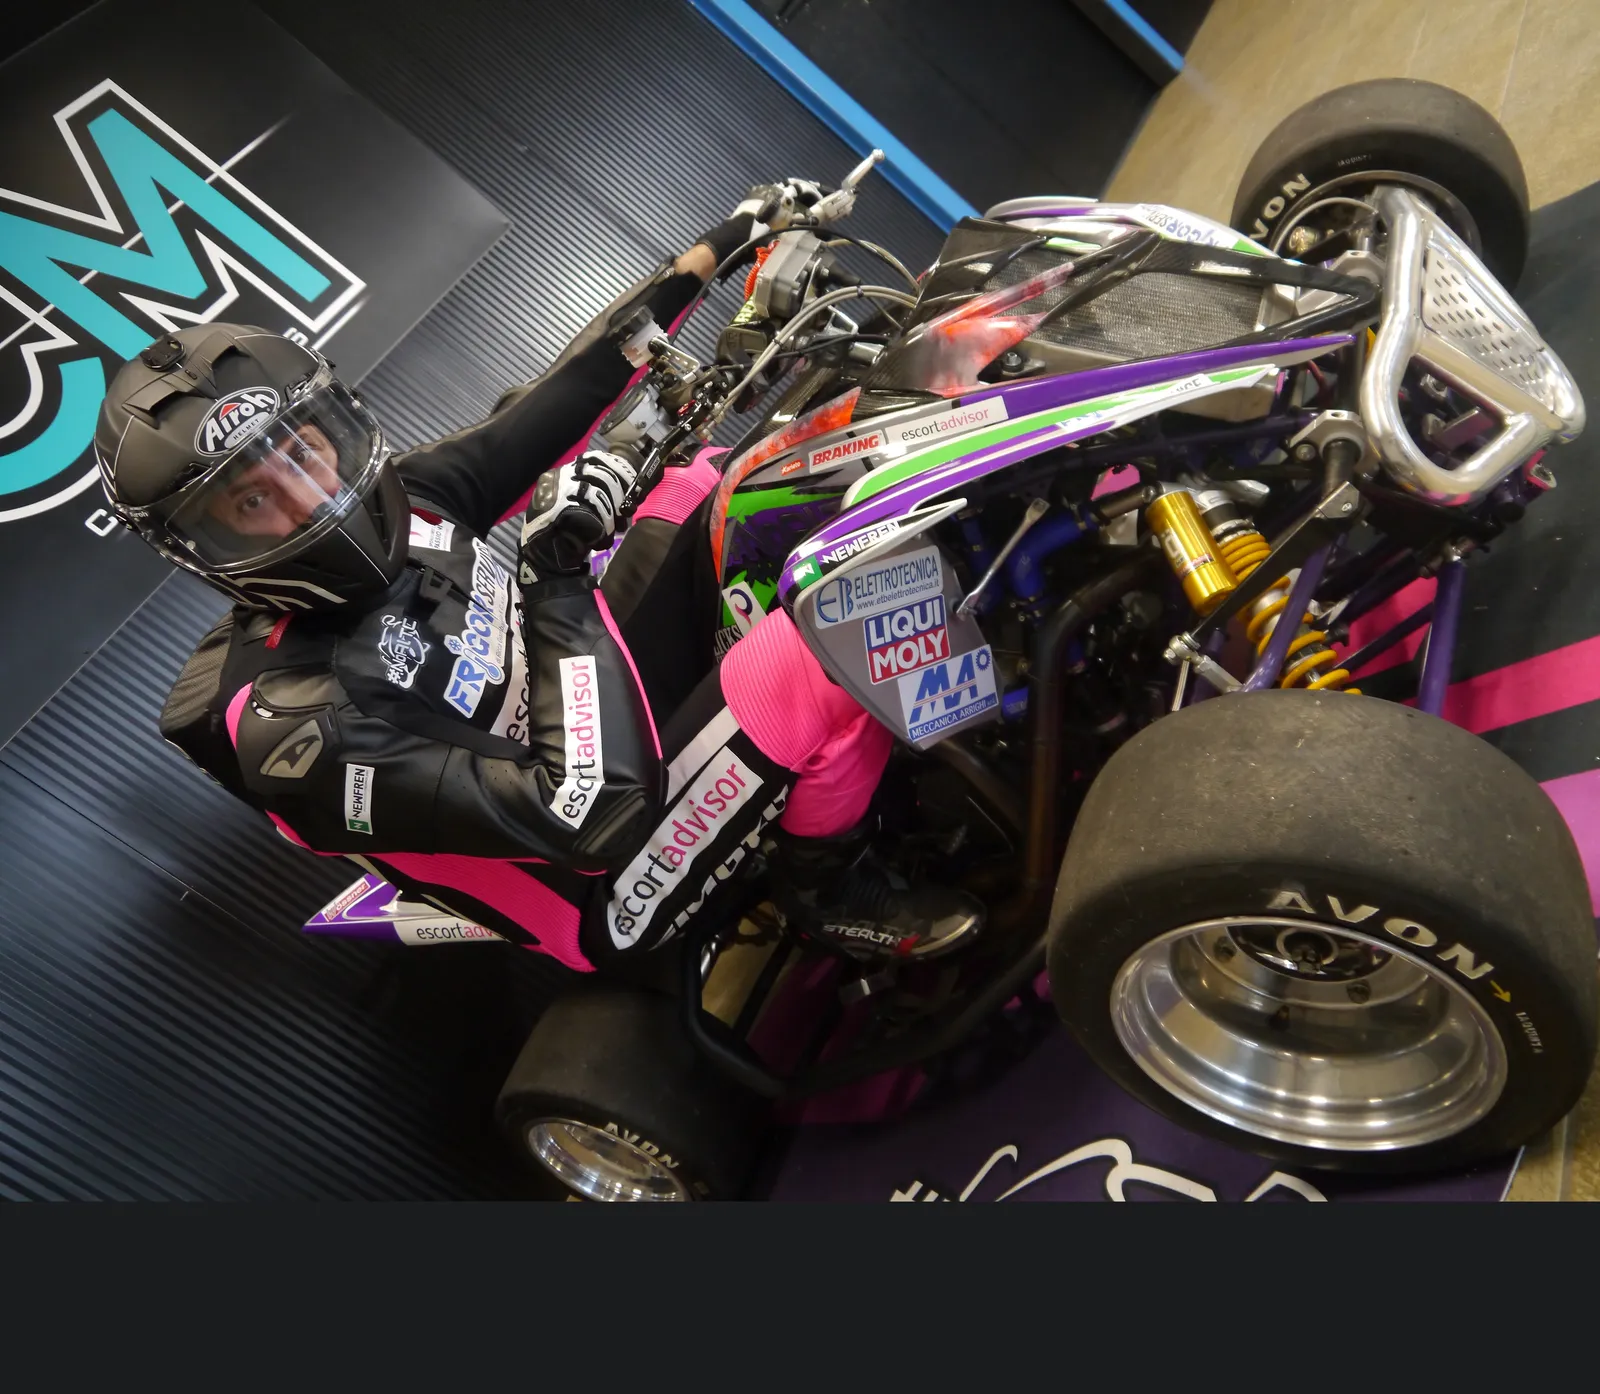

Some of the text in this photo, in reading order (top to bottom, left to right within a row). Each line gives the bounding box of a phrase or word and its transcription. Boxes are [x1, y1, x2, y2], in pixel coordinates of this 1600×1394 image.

[1248, 173, 1311, 239] VON
[205, 393, 276, 452] Airoh
[233, 418, 260, 440] HELMET
[901, 407, 989, 441] escortadvisor
[812, 434, 880, 466] BRAKING
[821, 520, 900, 564] NEWFREN
[855, 554, 939, 599] ELETTROTECNICA
[856, 579, 940, 610] www.etbelettrotecnica.it
[868, 598, 942, 648] LIQUI
[872, 628, 945, 680] MOLY
[562, 661, 597, 819] escortadvisor
[911, 713, 958, 739] MECCANICA
[960, 699, 987, 719] ARRIGHI
[352, 767, 366, 818] NEWFREN
[614, 763, 747, 936] escortadvisor
[416, 922, 493, 941] escortadv
[823, 924, 902, 947] STEALTH
[1266, 889, 1496, 981] AVON
[604, 1122, 680, 1169] AVON
